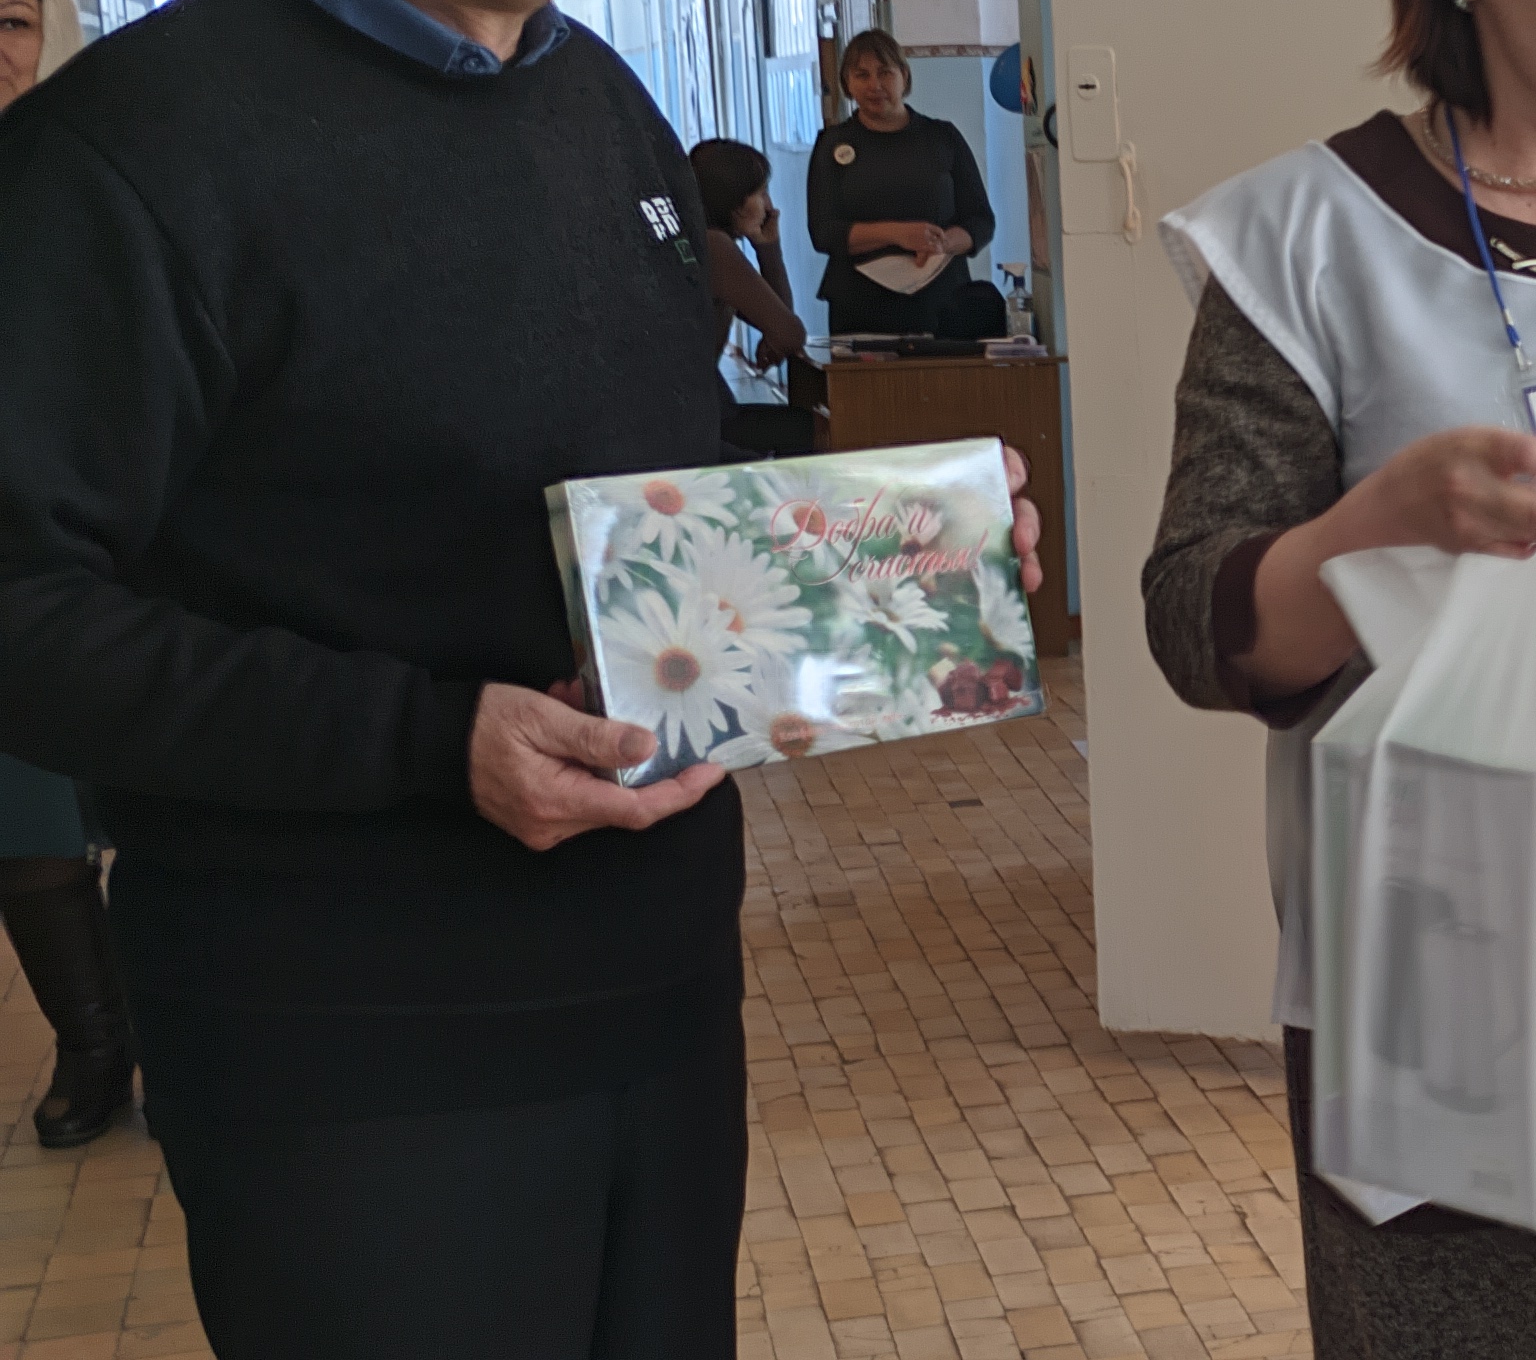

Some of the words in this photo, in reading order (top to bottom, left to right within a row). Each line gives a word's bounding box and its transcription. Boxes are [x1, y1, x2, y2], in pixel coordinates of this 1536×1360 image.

[770, 483, 897, 586] Добра
[907, 508, 928, 534] и
[848, 528, 989, 583] счастья!
